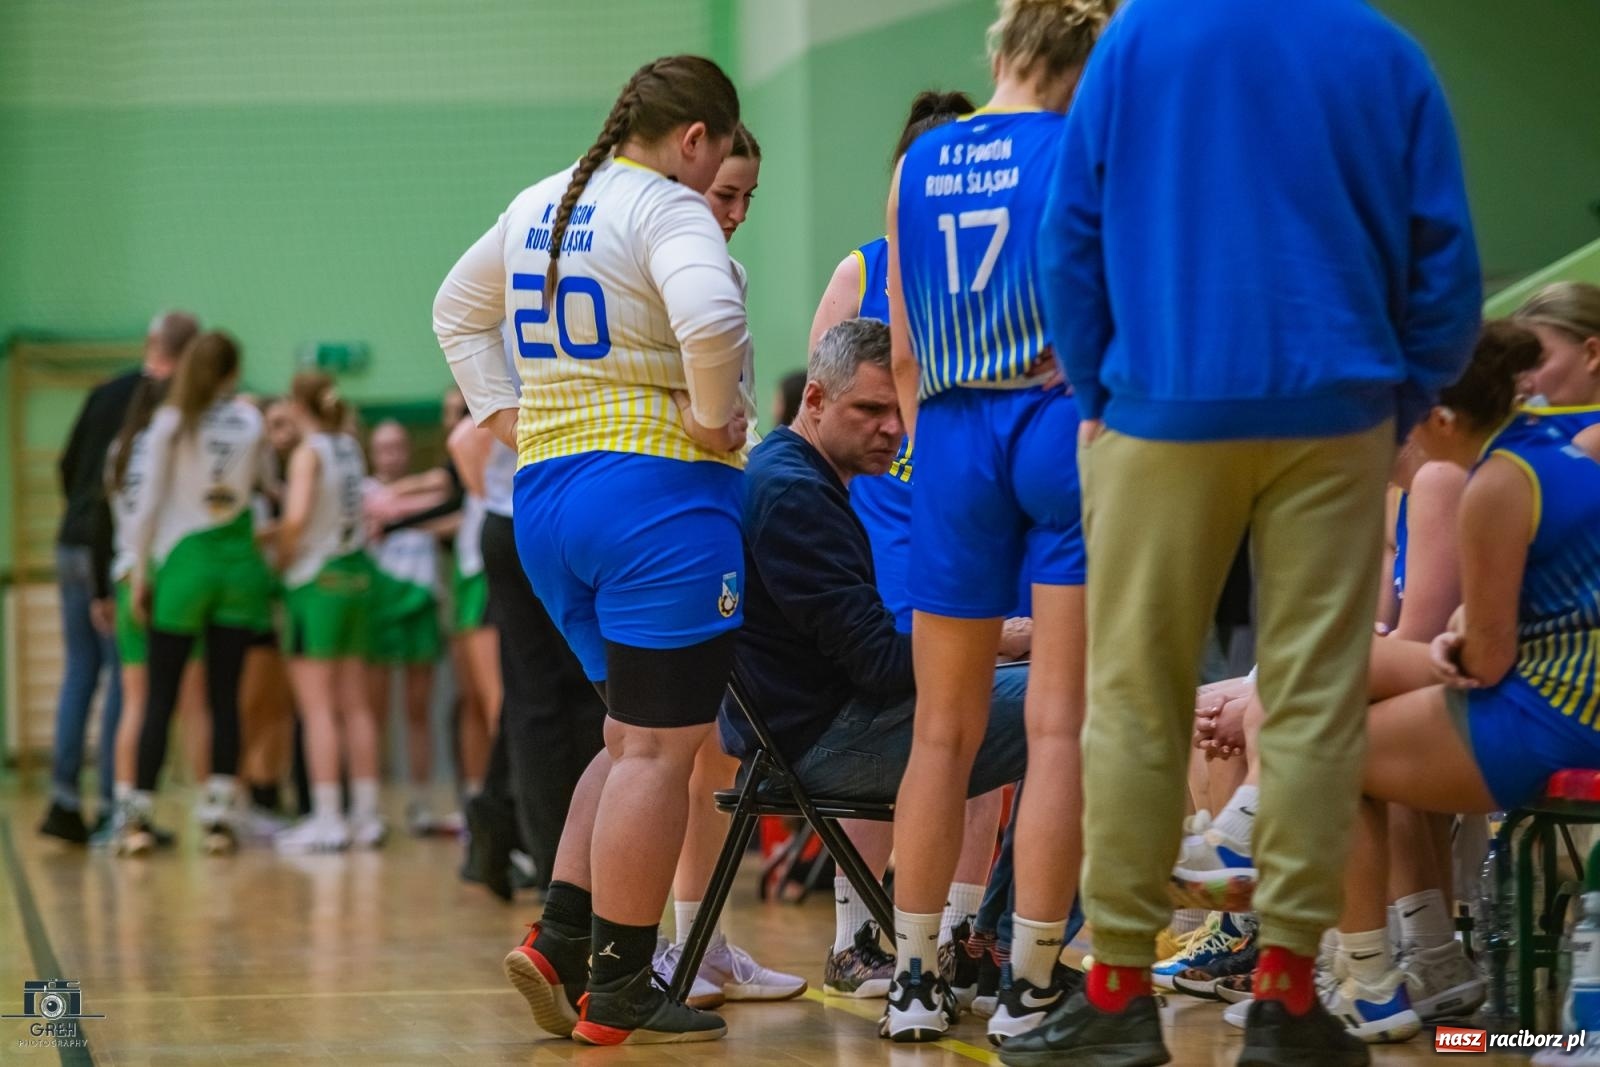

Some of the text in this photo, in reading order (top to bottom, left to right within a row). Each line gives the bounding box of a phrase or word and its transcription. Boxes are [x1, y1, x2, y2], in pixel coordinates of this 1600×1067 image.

[939, 144, 951, 166] K
[952, 143, 964, 165] S
[925, 166, 1020, 198] RUDA ŚLĄSKA
[541, 200, 597, 225] K OGOŃ
[561, 230, 594, 257] LĄSKA
[938, 206, 1010, 295] 17
[512, 272, 612, 360] 20
